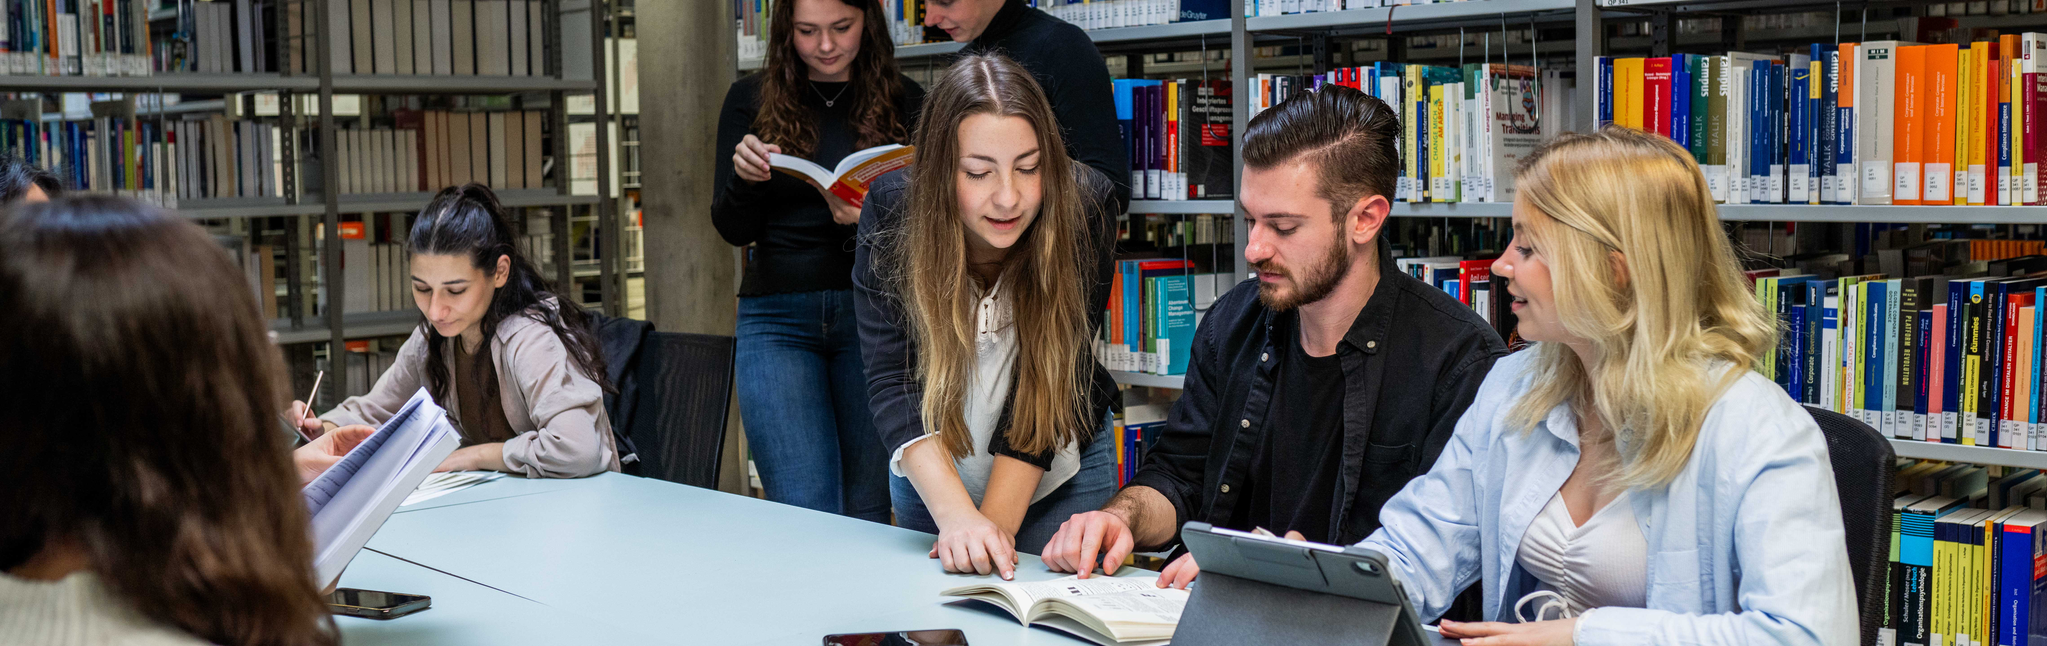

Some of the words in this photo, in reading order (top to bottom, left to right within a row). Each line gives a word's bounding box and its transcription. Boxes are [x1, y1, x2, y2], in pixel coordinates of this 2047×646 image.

[1699, 56, 1710, 97] campus
[1716, 55, 1728, 97] campus
[1438, 126, 1444, 138] AM
[1695, 115, 1703, 147] MALIK
[1711, 115, 1720, 147] MALIK
[1823, 144, 1831, 176] MALIK
[1808, 320, 1816, 355] Governance
[1904, 315, 1912, 346] PLATFORM
[1807, 356, 1815, 384] Corporate
[1903, 349, 1911, 386] REVOLUTION
[1916, 567, 1927, 639] Organisationspsychologie
